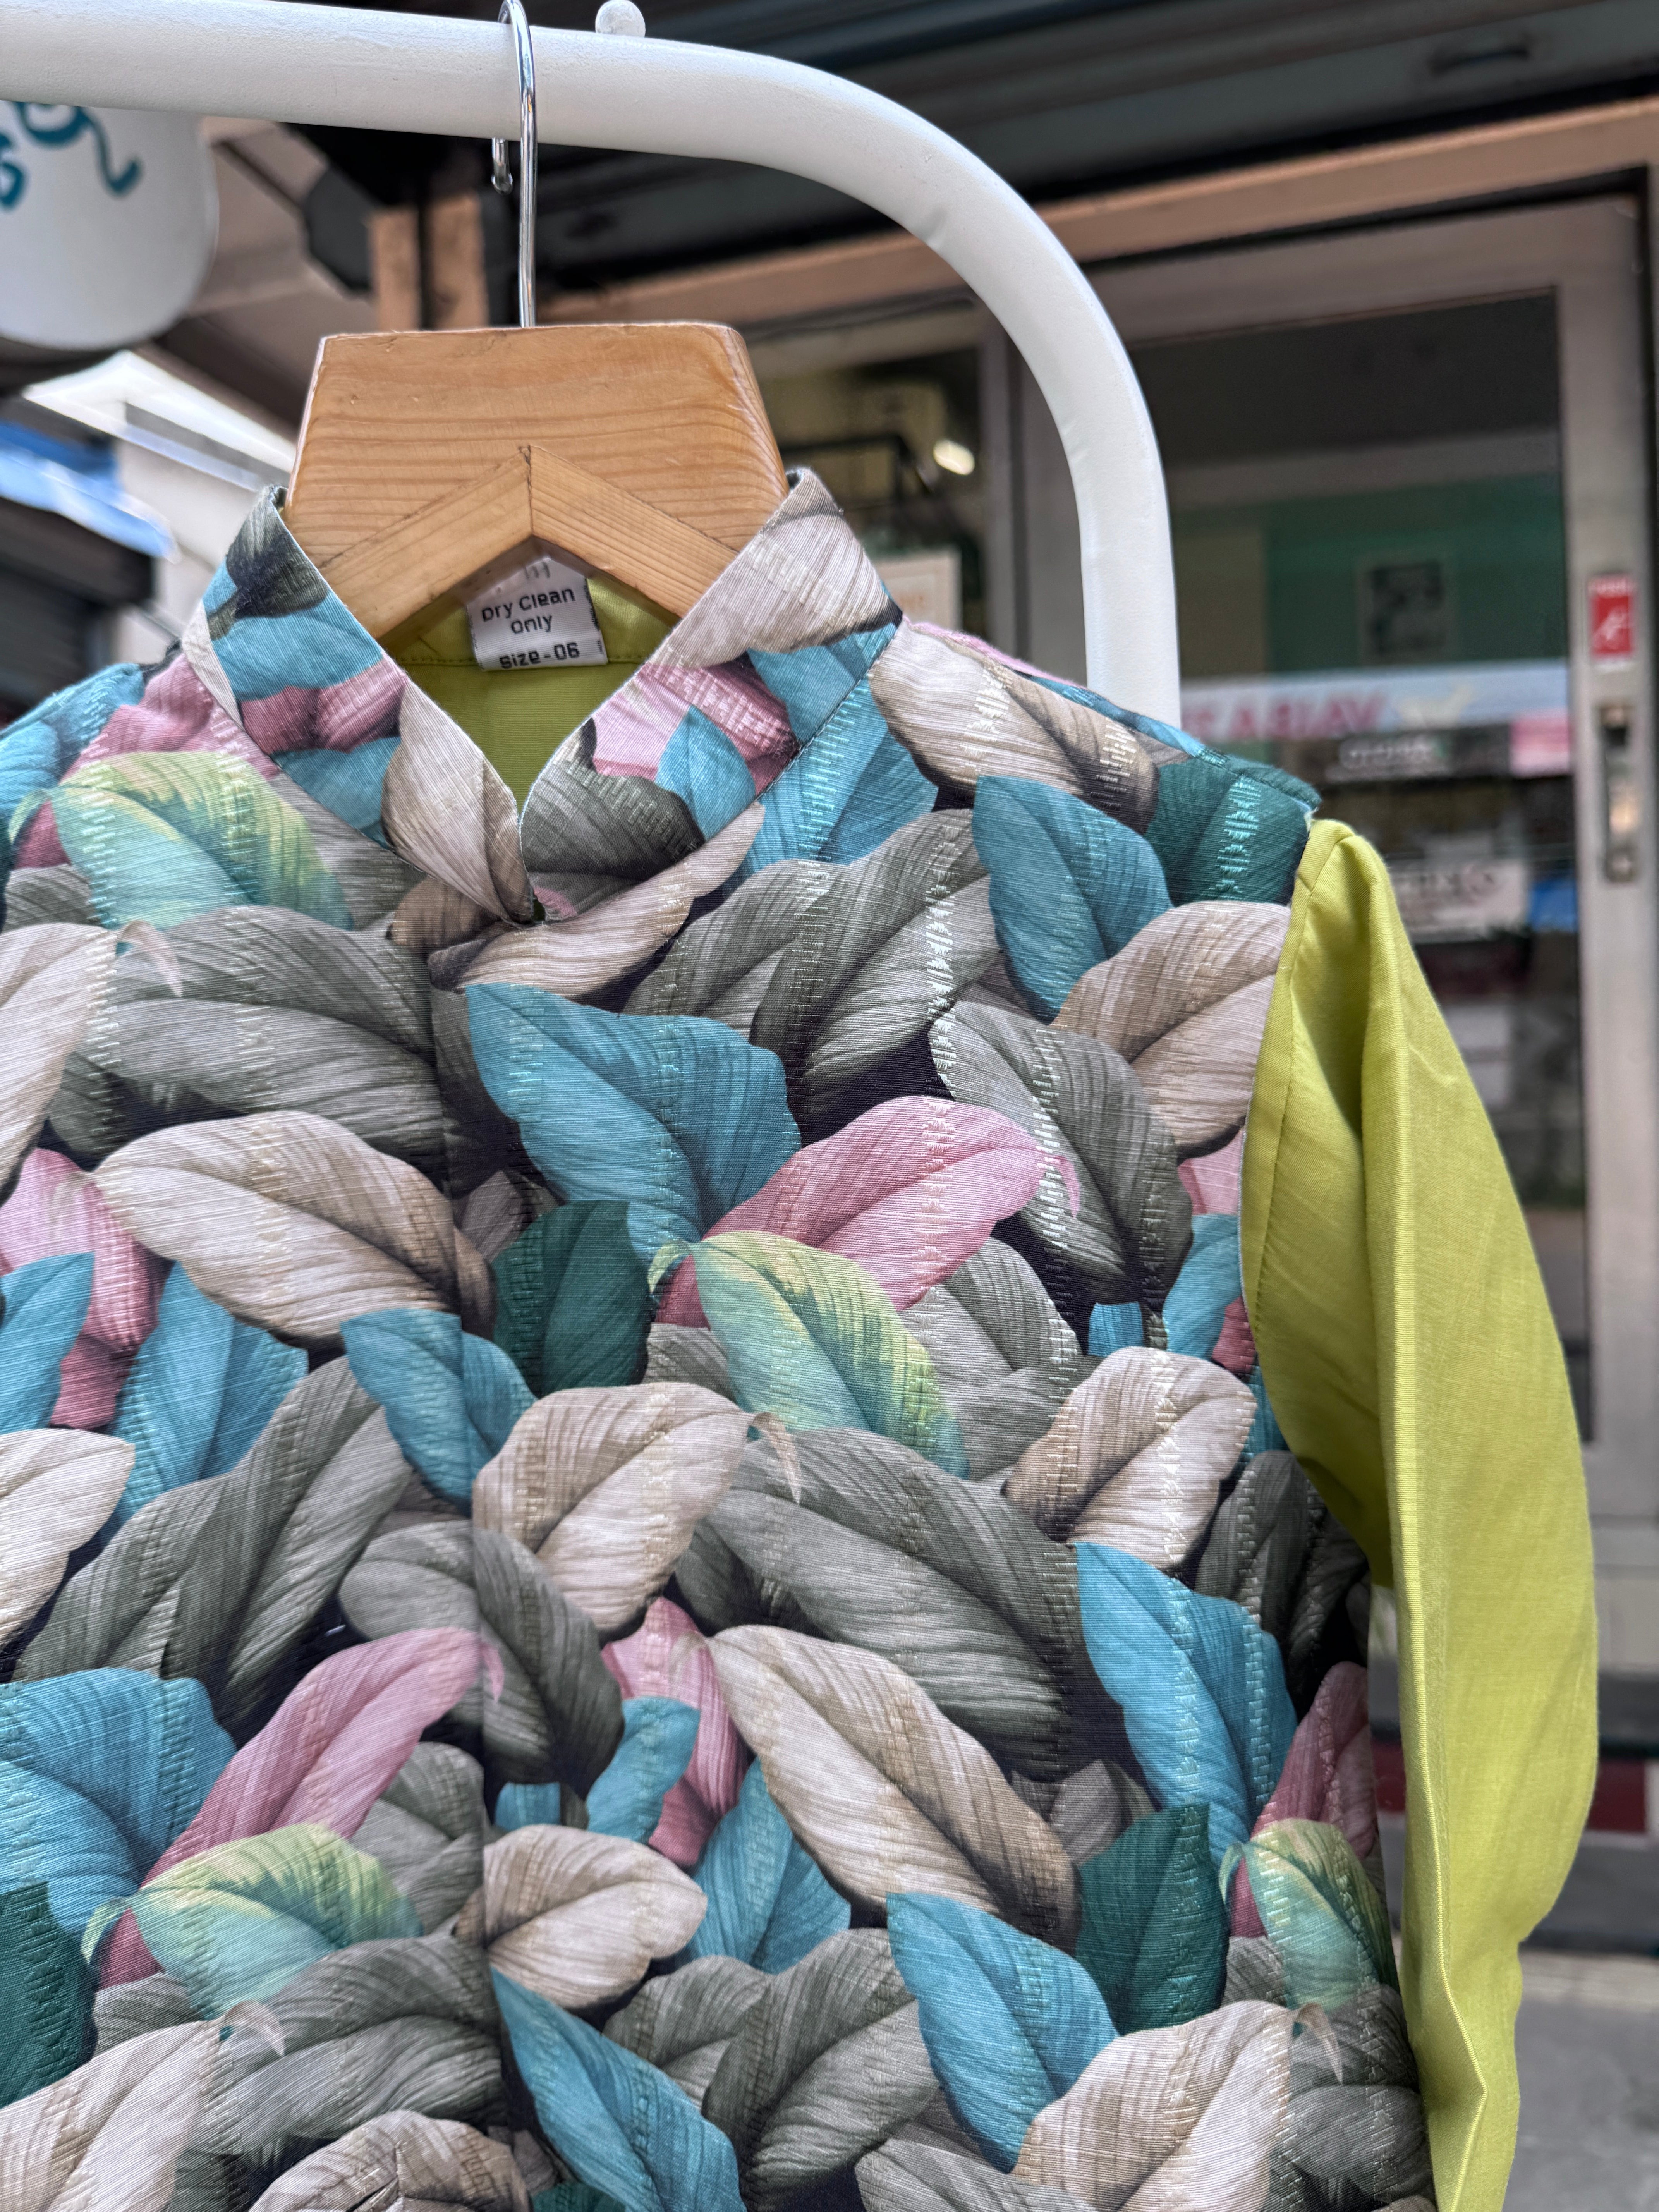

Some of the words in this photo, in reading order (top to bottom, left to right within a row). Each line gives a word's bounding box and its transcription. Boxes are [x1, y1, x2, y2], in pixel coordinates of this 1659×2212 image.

[482, 603, 513, 622] Dry
[519, 588, 575, 611] Clean
[511, 615, 553, 635] Only
